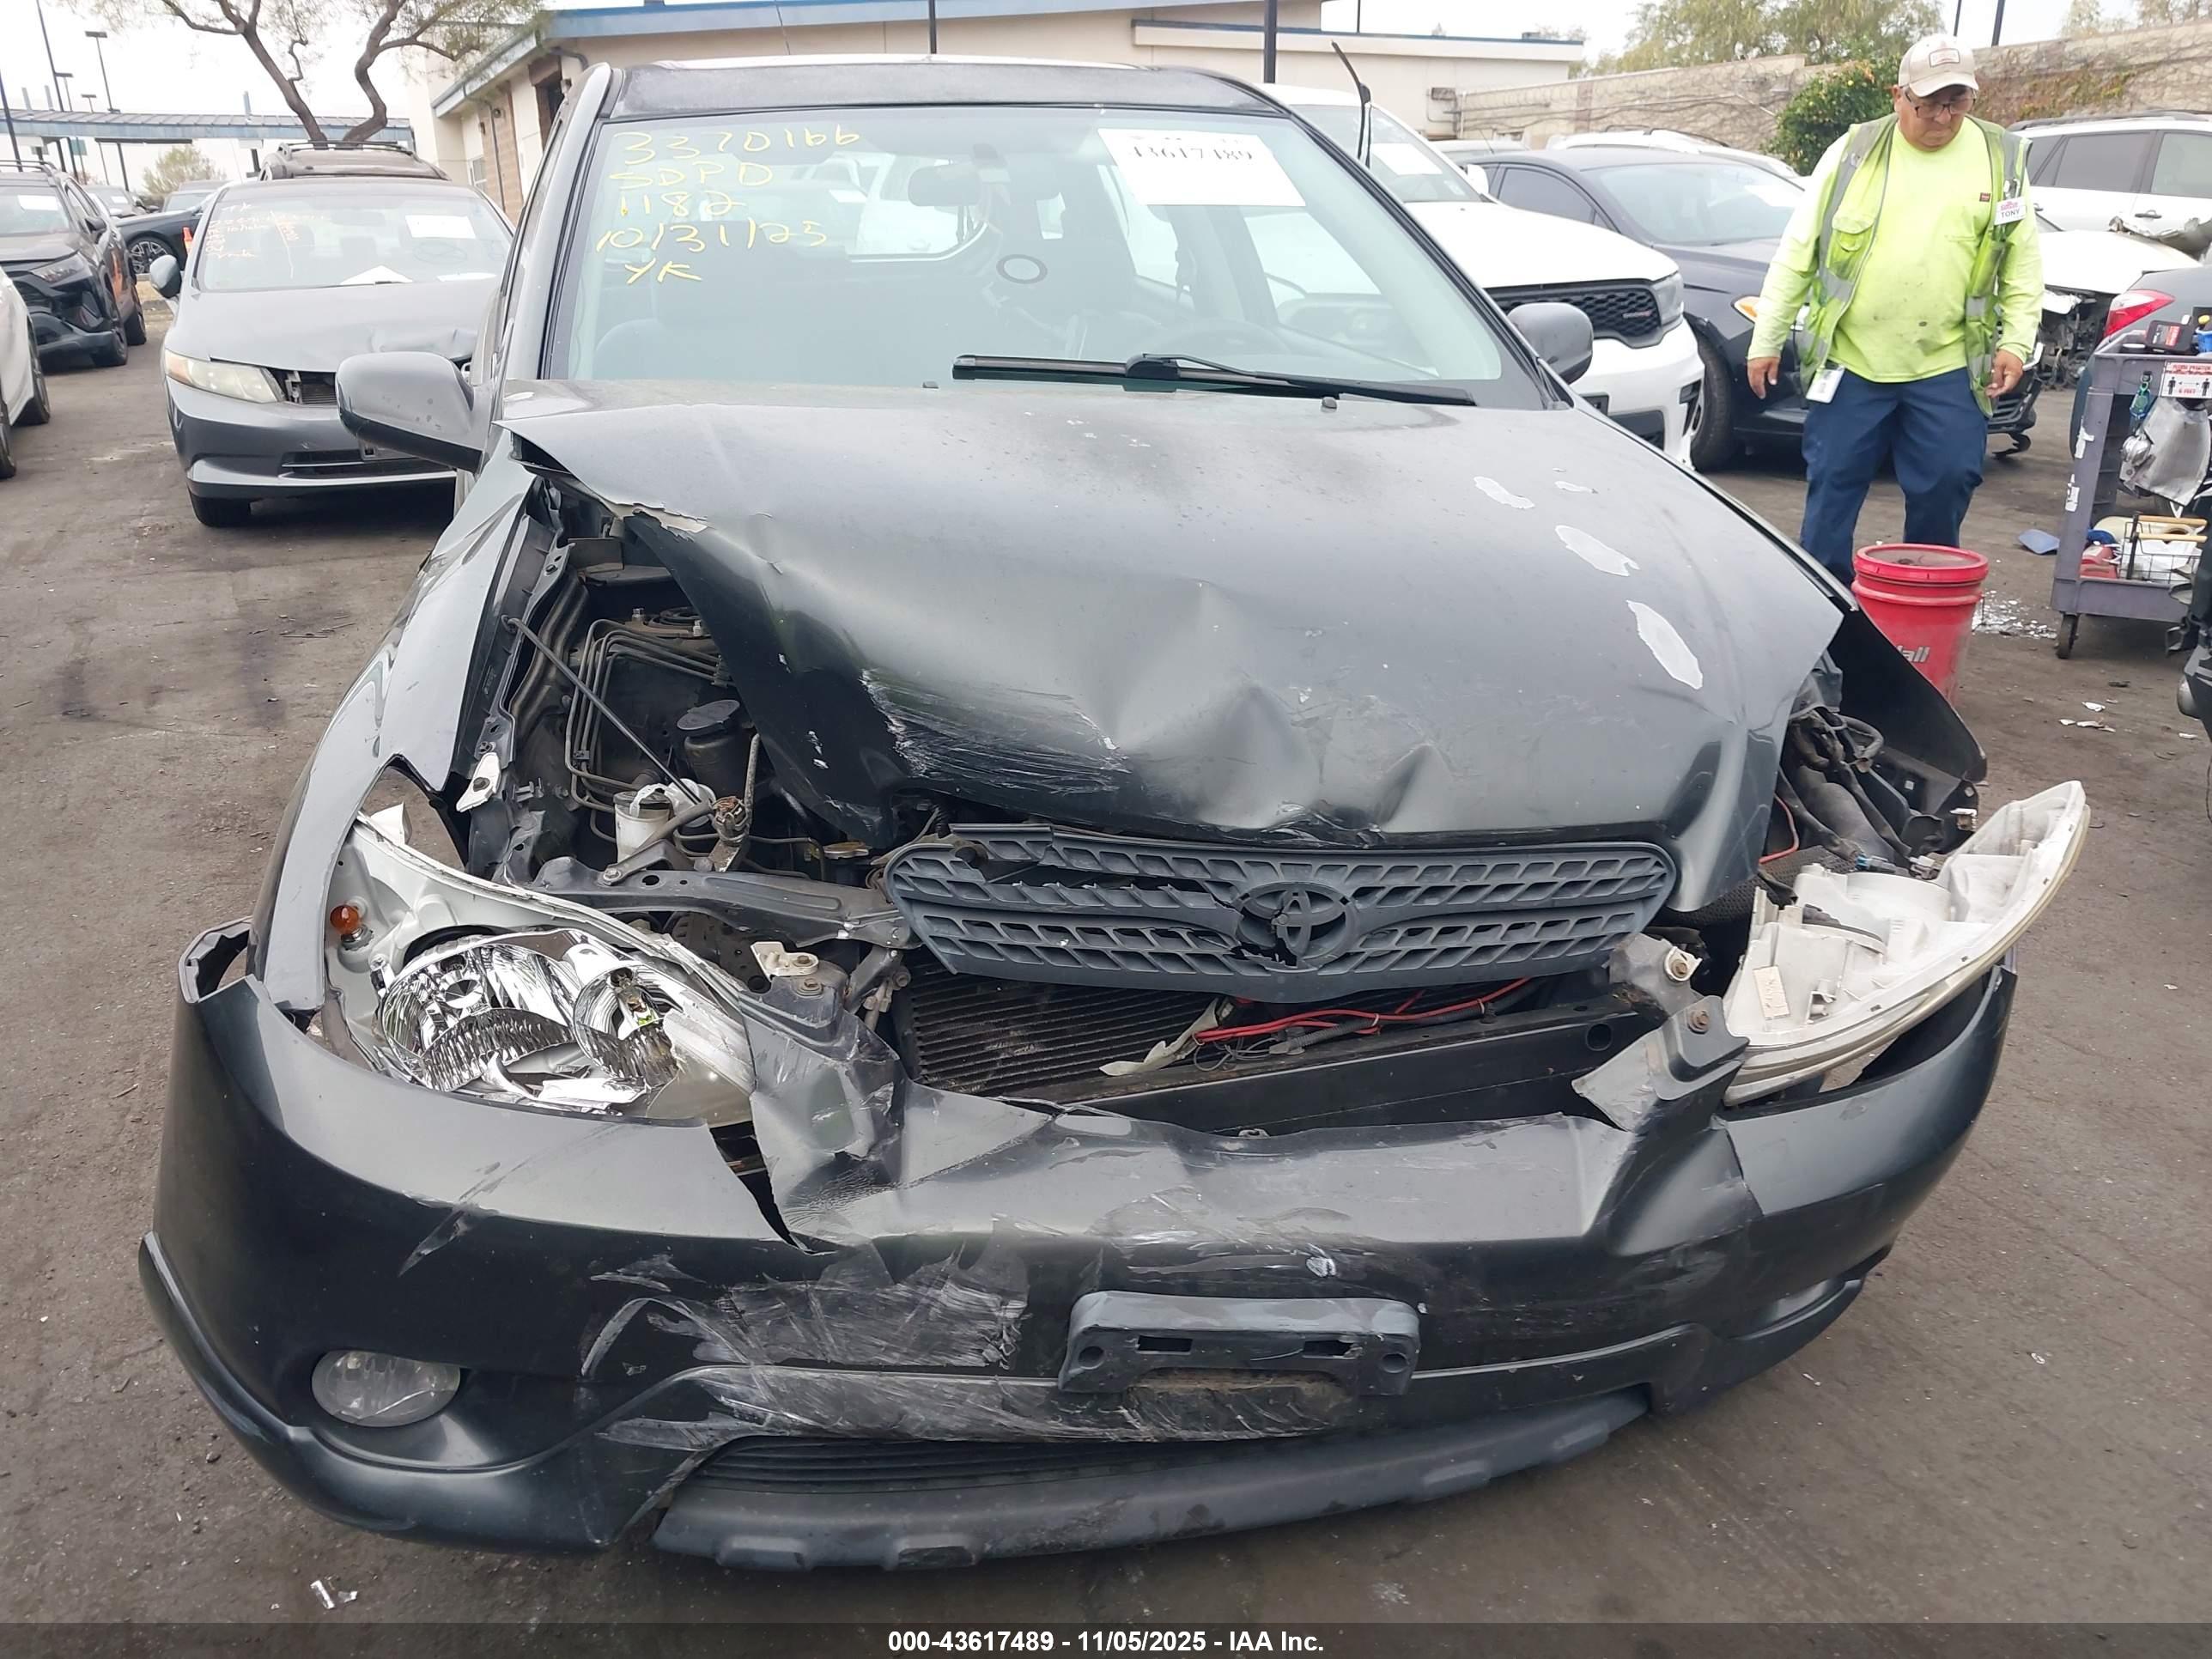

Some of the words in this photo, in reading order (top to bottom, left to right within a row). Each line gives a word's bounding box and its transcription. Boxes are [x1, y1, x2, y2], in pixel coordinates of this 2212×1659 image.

[609, 161, 773, 190] SDPD
[619, 191, 747, 216] 1182
[2001, 208, 2021, 219] TONY
